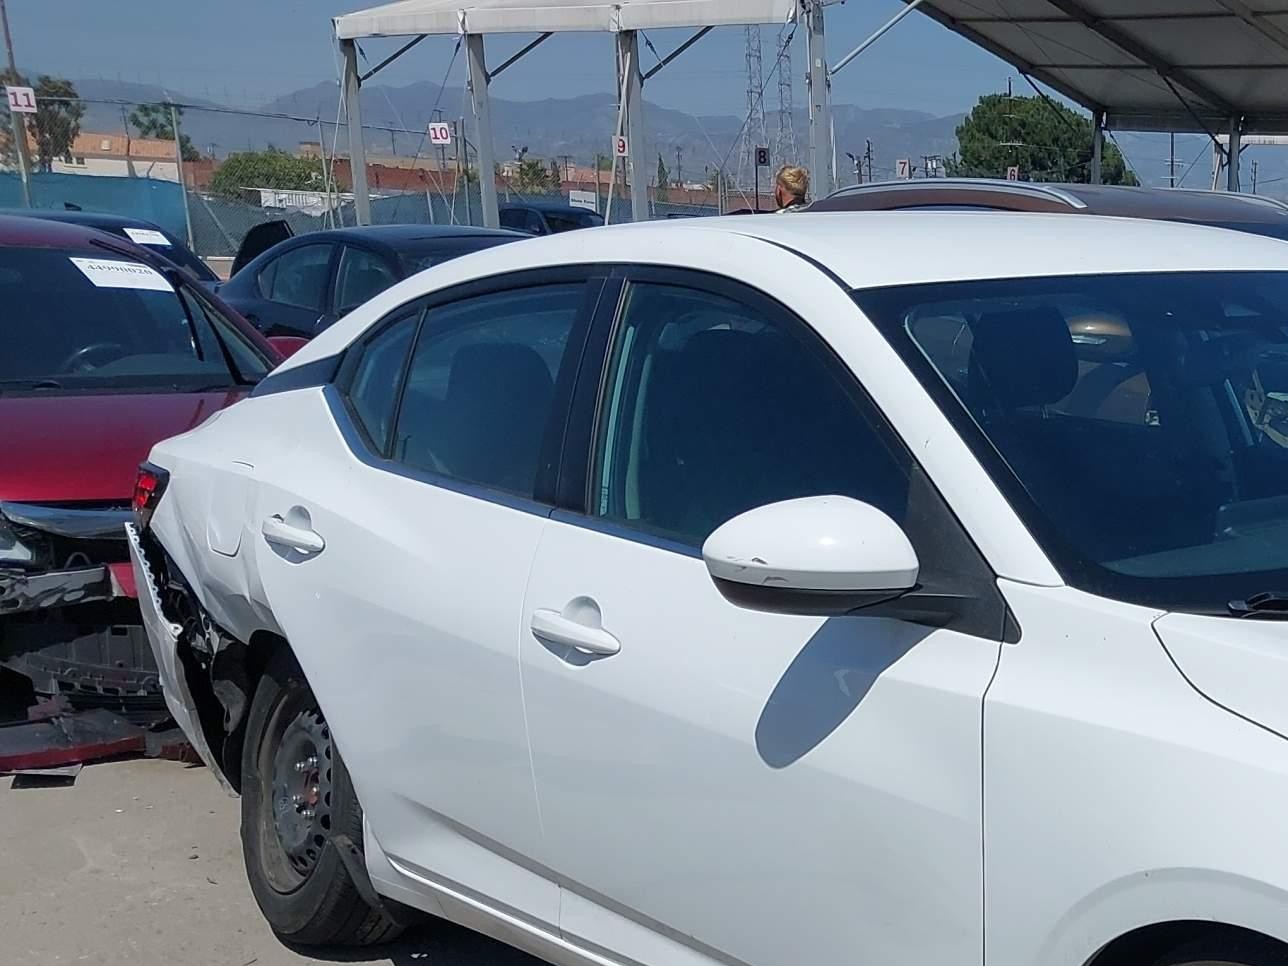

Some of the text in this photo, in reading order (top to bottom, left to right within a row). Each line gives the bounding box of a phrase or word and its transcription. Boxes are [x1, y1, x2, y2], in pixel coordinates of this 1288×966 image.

[9, 91, 36, 109] 11
[430, 126, 449, 141] 10
[617, 138, 626, 154] 9
[758, 148, 767, 164] 8
[899, 161, 908, 176] 7
[1009, 168, 1016, 181] 6
